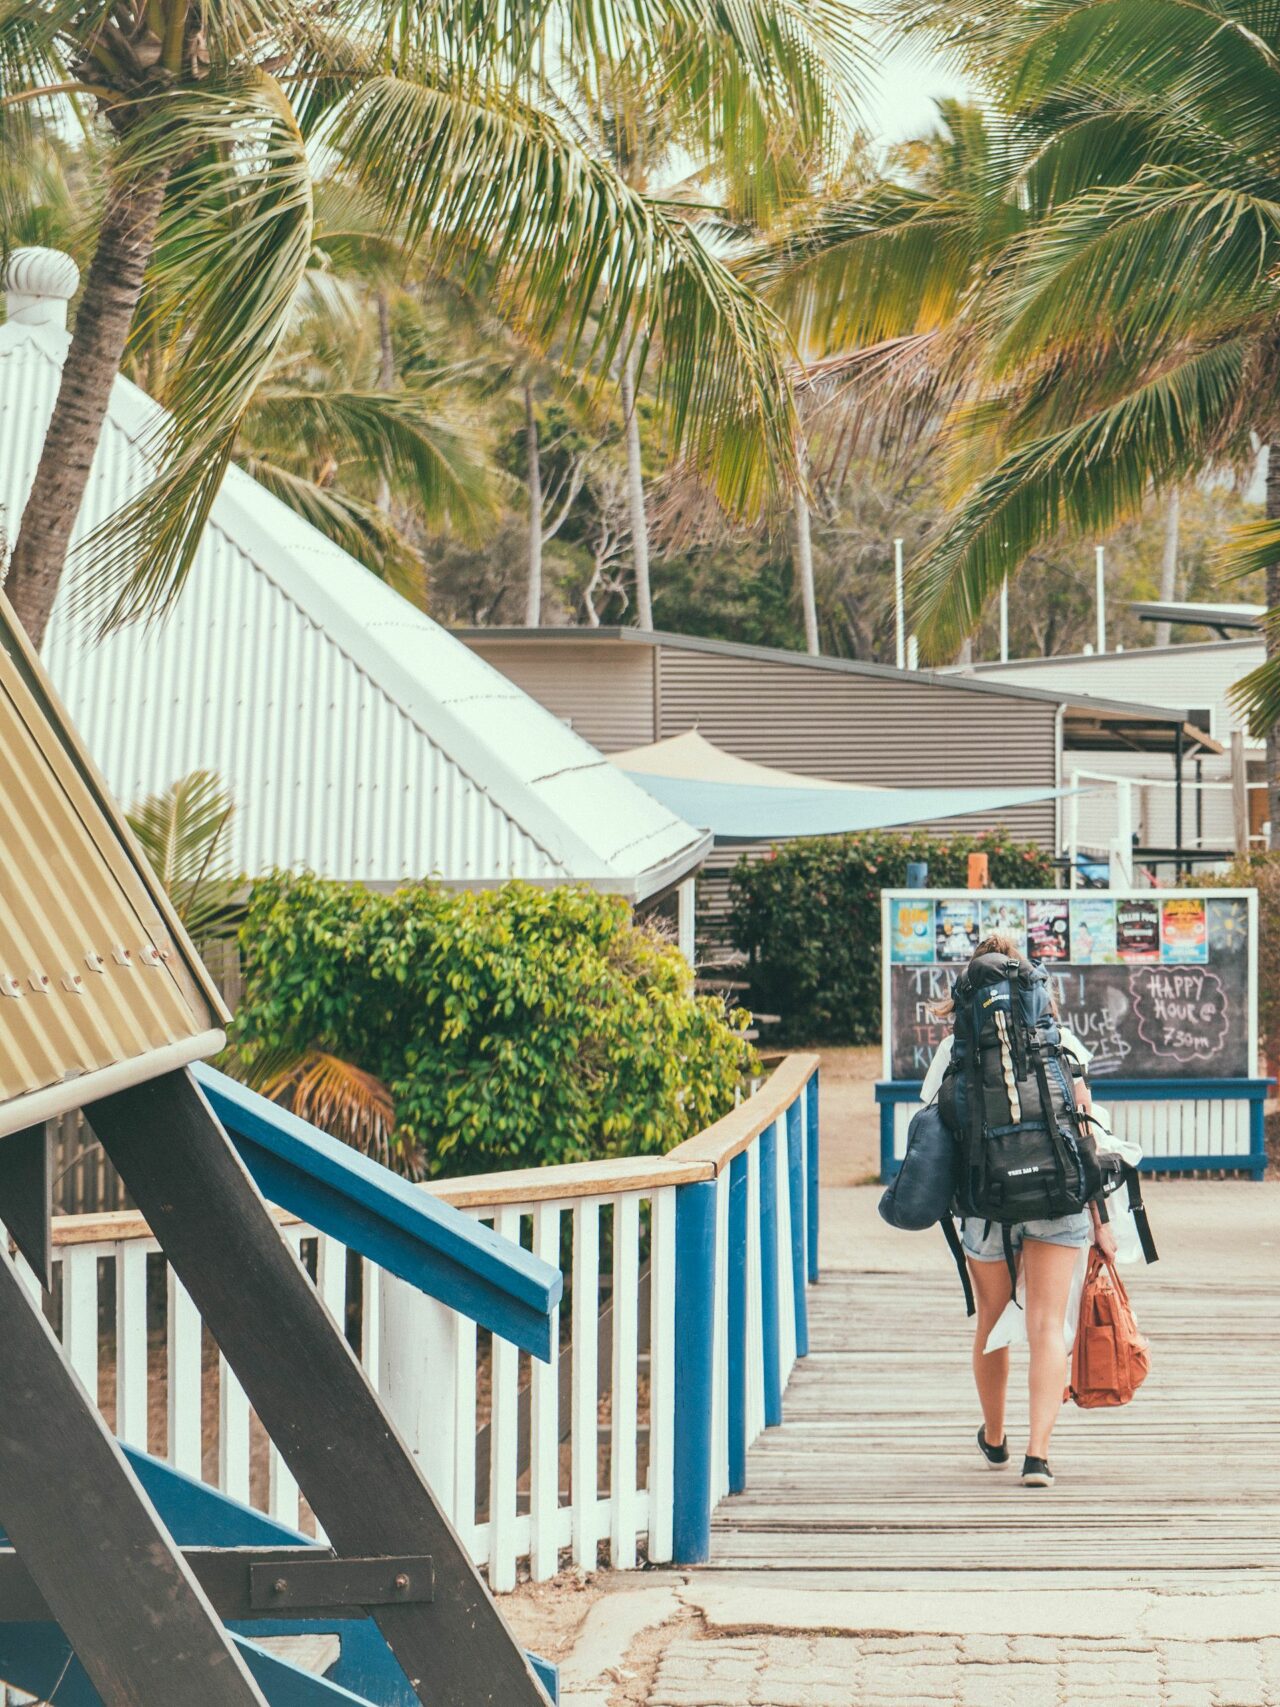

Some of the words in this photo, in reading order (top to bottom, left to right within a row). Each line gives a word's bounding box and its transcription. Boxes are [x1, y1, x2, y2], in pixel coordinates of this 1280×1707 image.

[1146, 975, 1204, 1001] HAPPY
[1058, 1008, 1117, 1036] HUGE
[1154, 998, 1199, 1024] HOUR
[1163, 1027, 1209, 1051] 730pm
